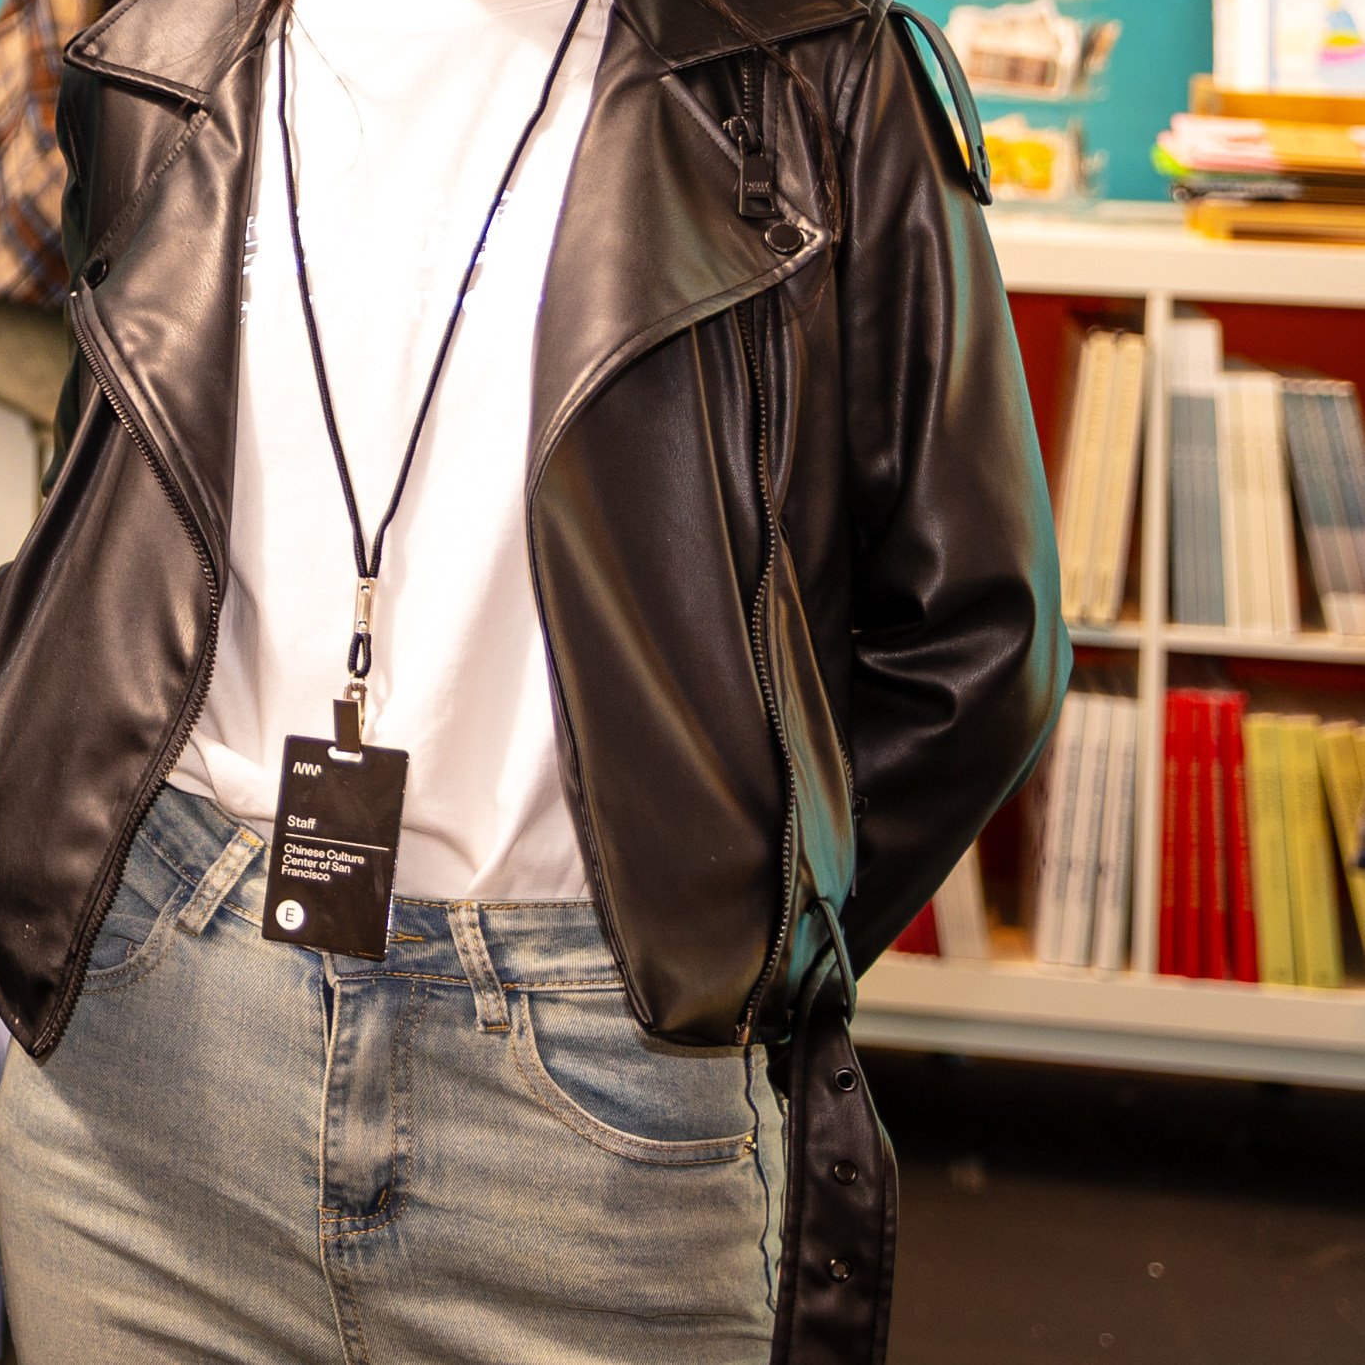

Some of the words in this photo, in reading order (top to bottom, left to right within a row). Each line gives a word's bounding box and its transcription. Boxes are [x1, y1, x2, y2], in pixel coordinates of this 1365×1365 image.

[287, 815, 317, 830] Staff
[284, 843, 325, 858] Chinese
[326, 849, 365, 864] Culture
[282, 855, 318, 869] Center
[319, 860, 331, 871] of
[331, 861, 351, 874] San
[281, 865, 330, 882] Francisco
[285, 907, 295, 923] E
